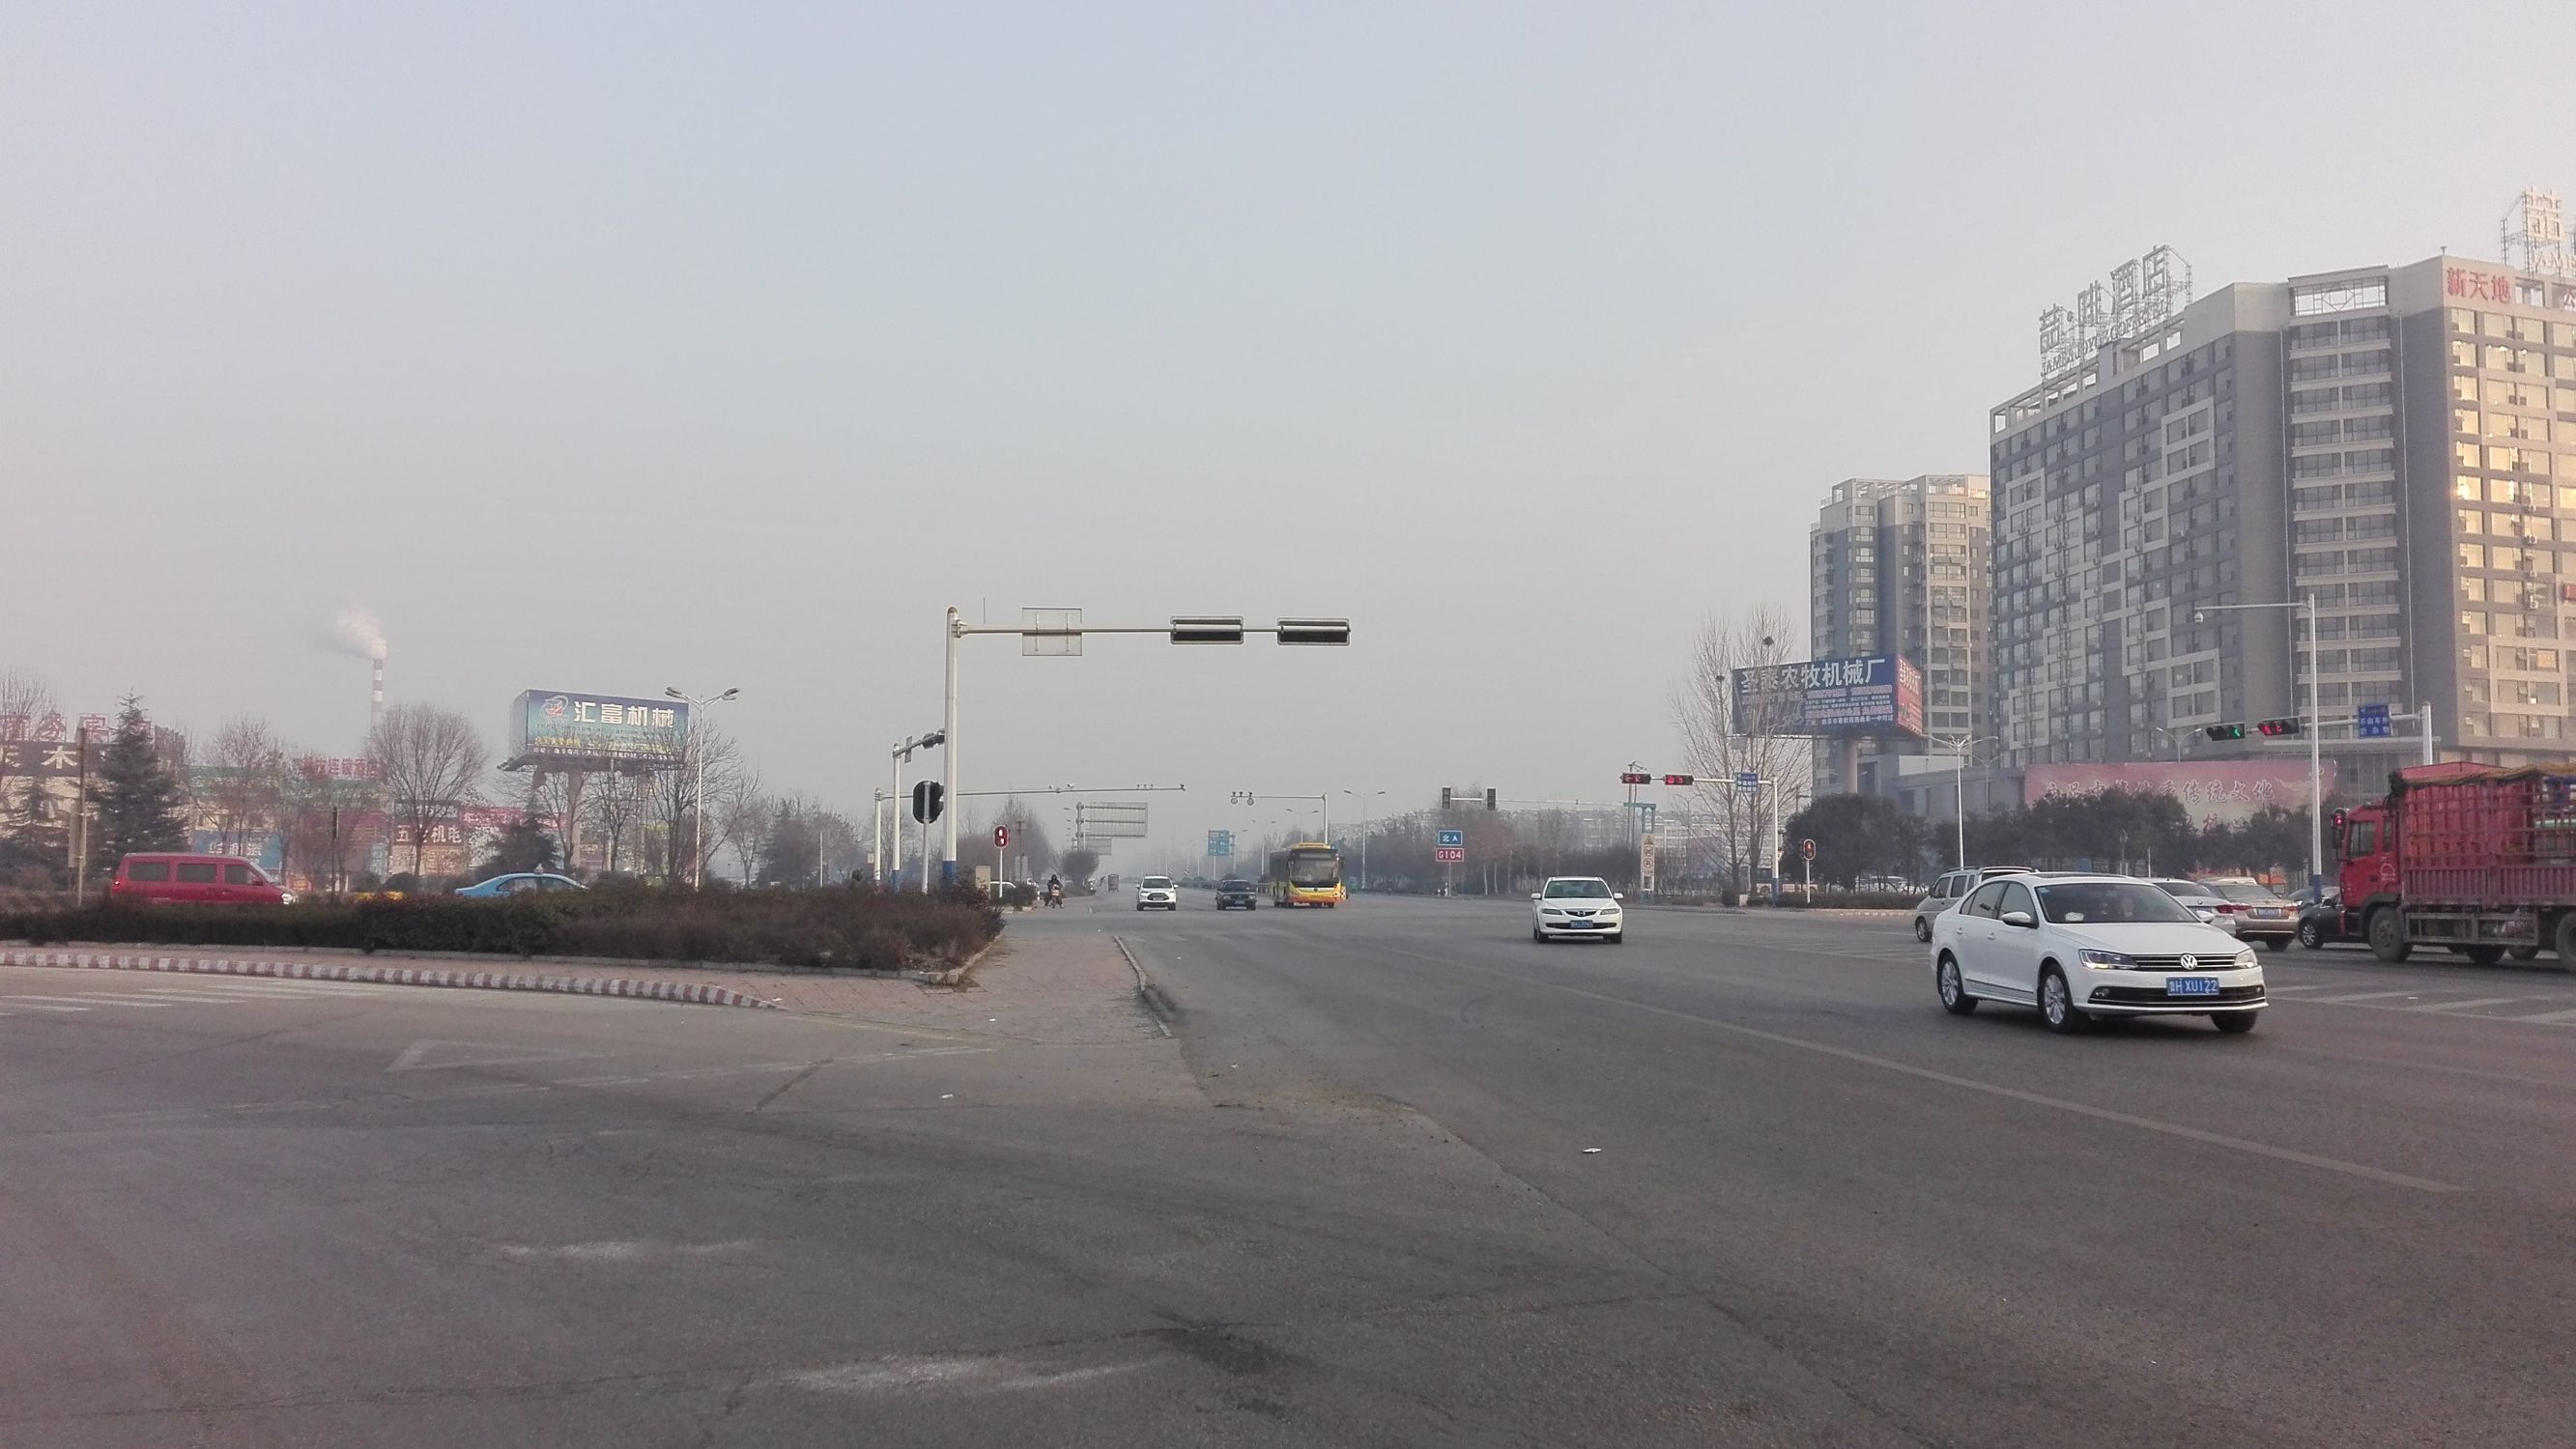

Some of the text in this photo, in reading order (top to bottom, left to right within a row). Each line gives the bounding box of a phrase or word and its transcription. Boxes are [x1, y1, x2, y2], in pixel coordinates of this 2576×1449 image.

[2447, 267, 2511, 304] 新天地
[1739, 658, 1886, 695] 圣泰农牧机械厂
[573, 700, 674, 728] 汇富机械
[396, 823, 462, 843] 五机电
[1438, 850, 1461, 859] G104
